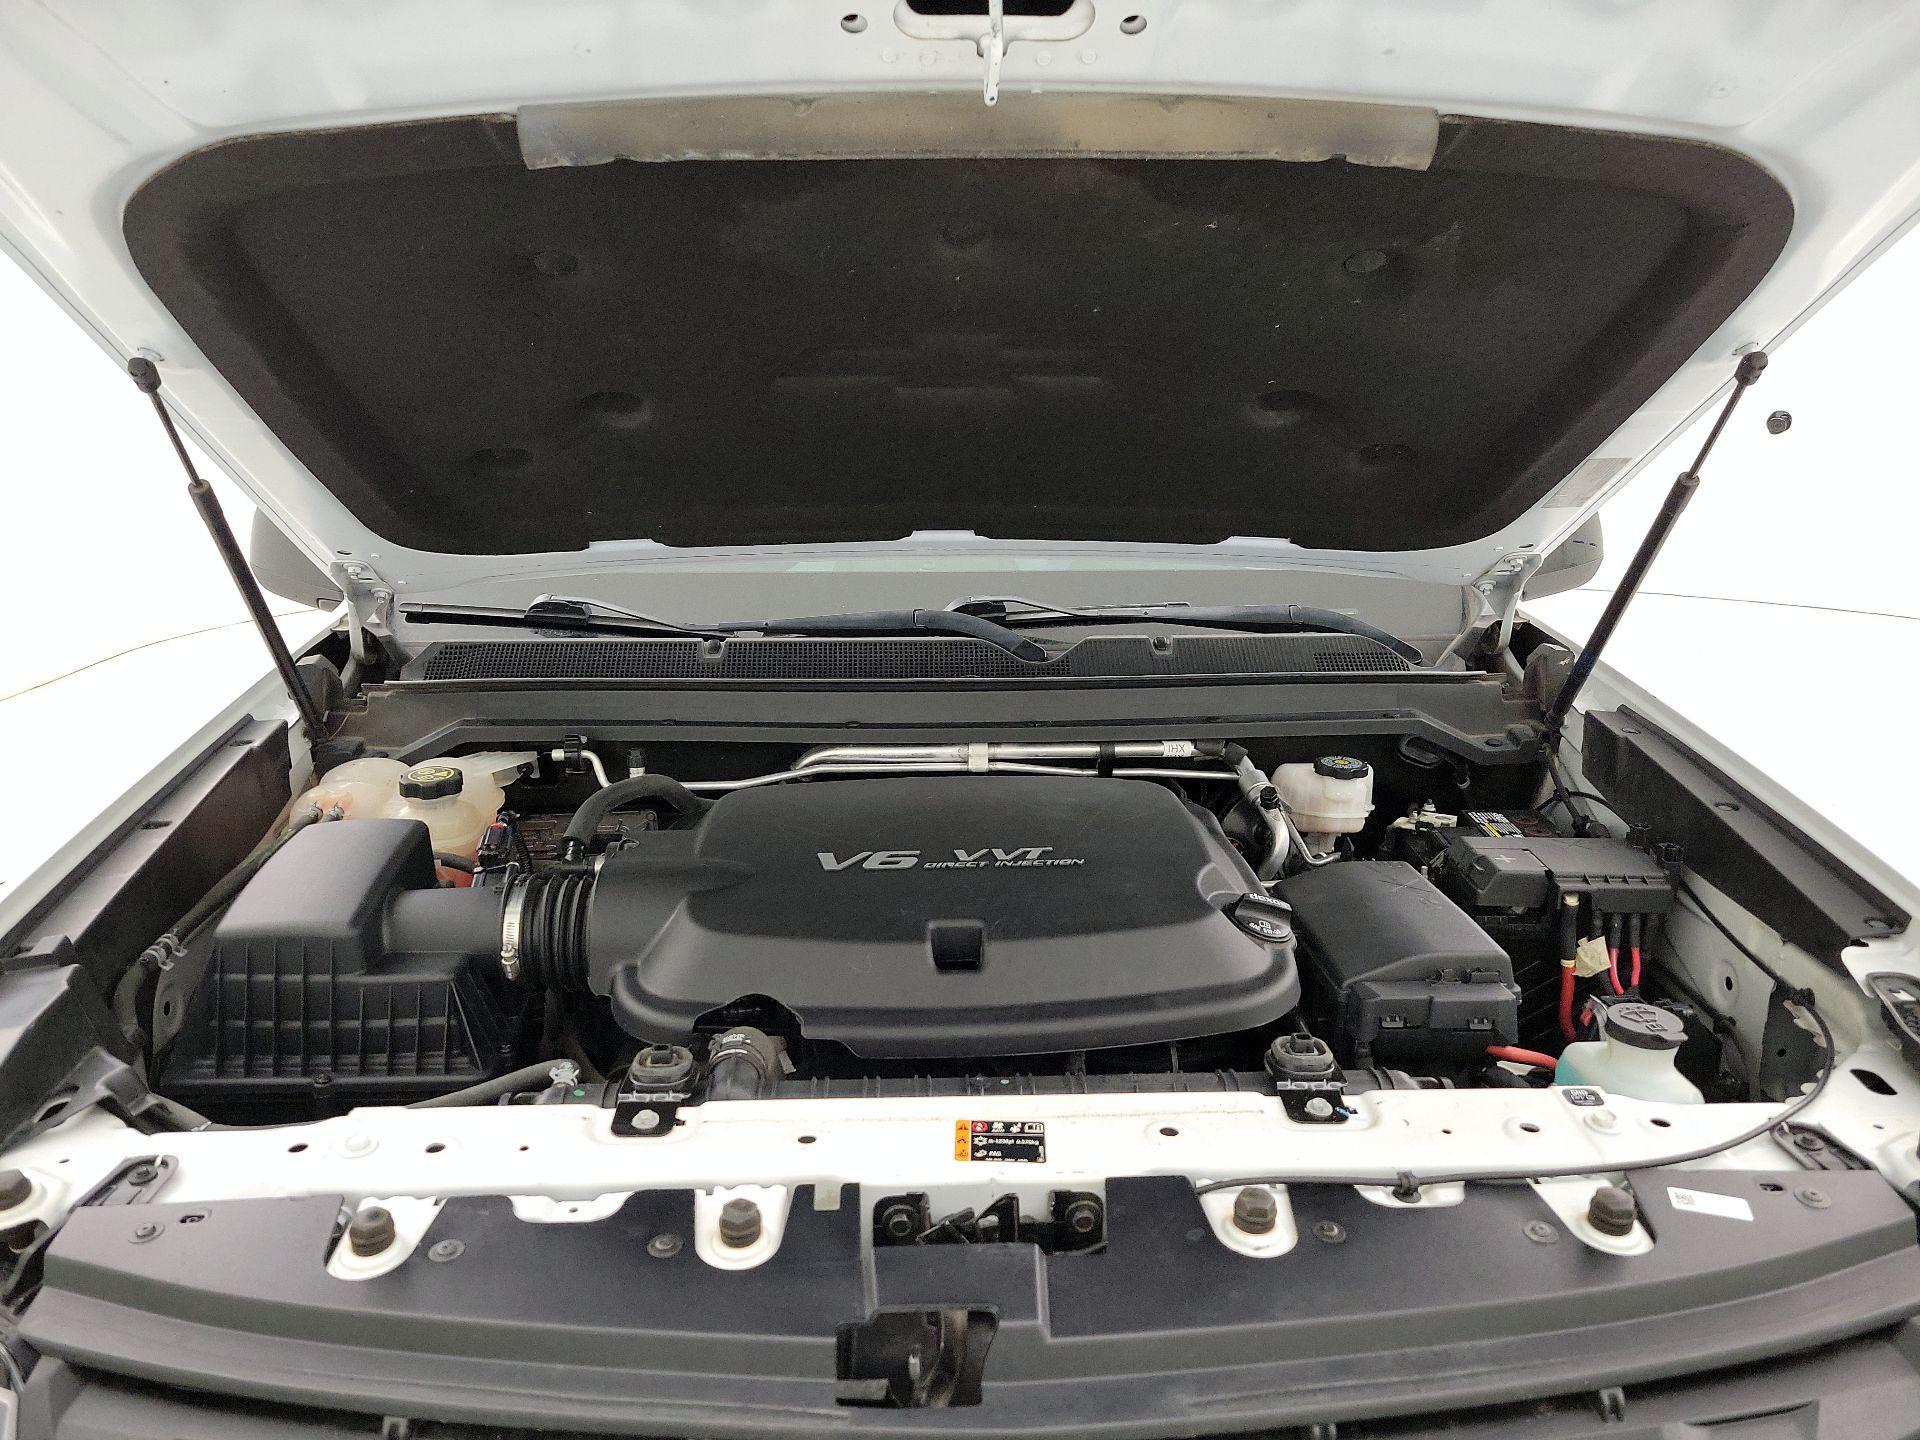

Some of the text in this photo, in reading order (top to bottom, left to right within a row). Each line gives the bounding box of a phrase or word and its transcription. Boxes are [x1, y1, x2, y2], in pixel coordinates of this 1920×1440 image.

[817, 850, 921, 871] V6
[953, 847, 1054, 862] VVT
[923, 858, 1085, 869] DIRECT INJECTION
